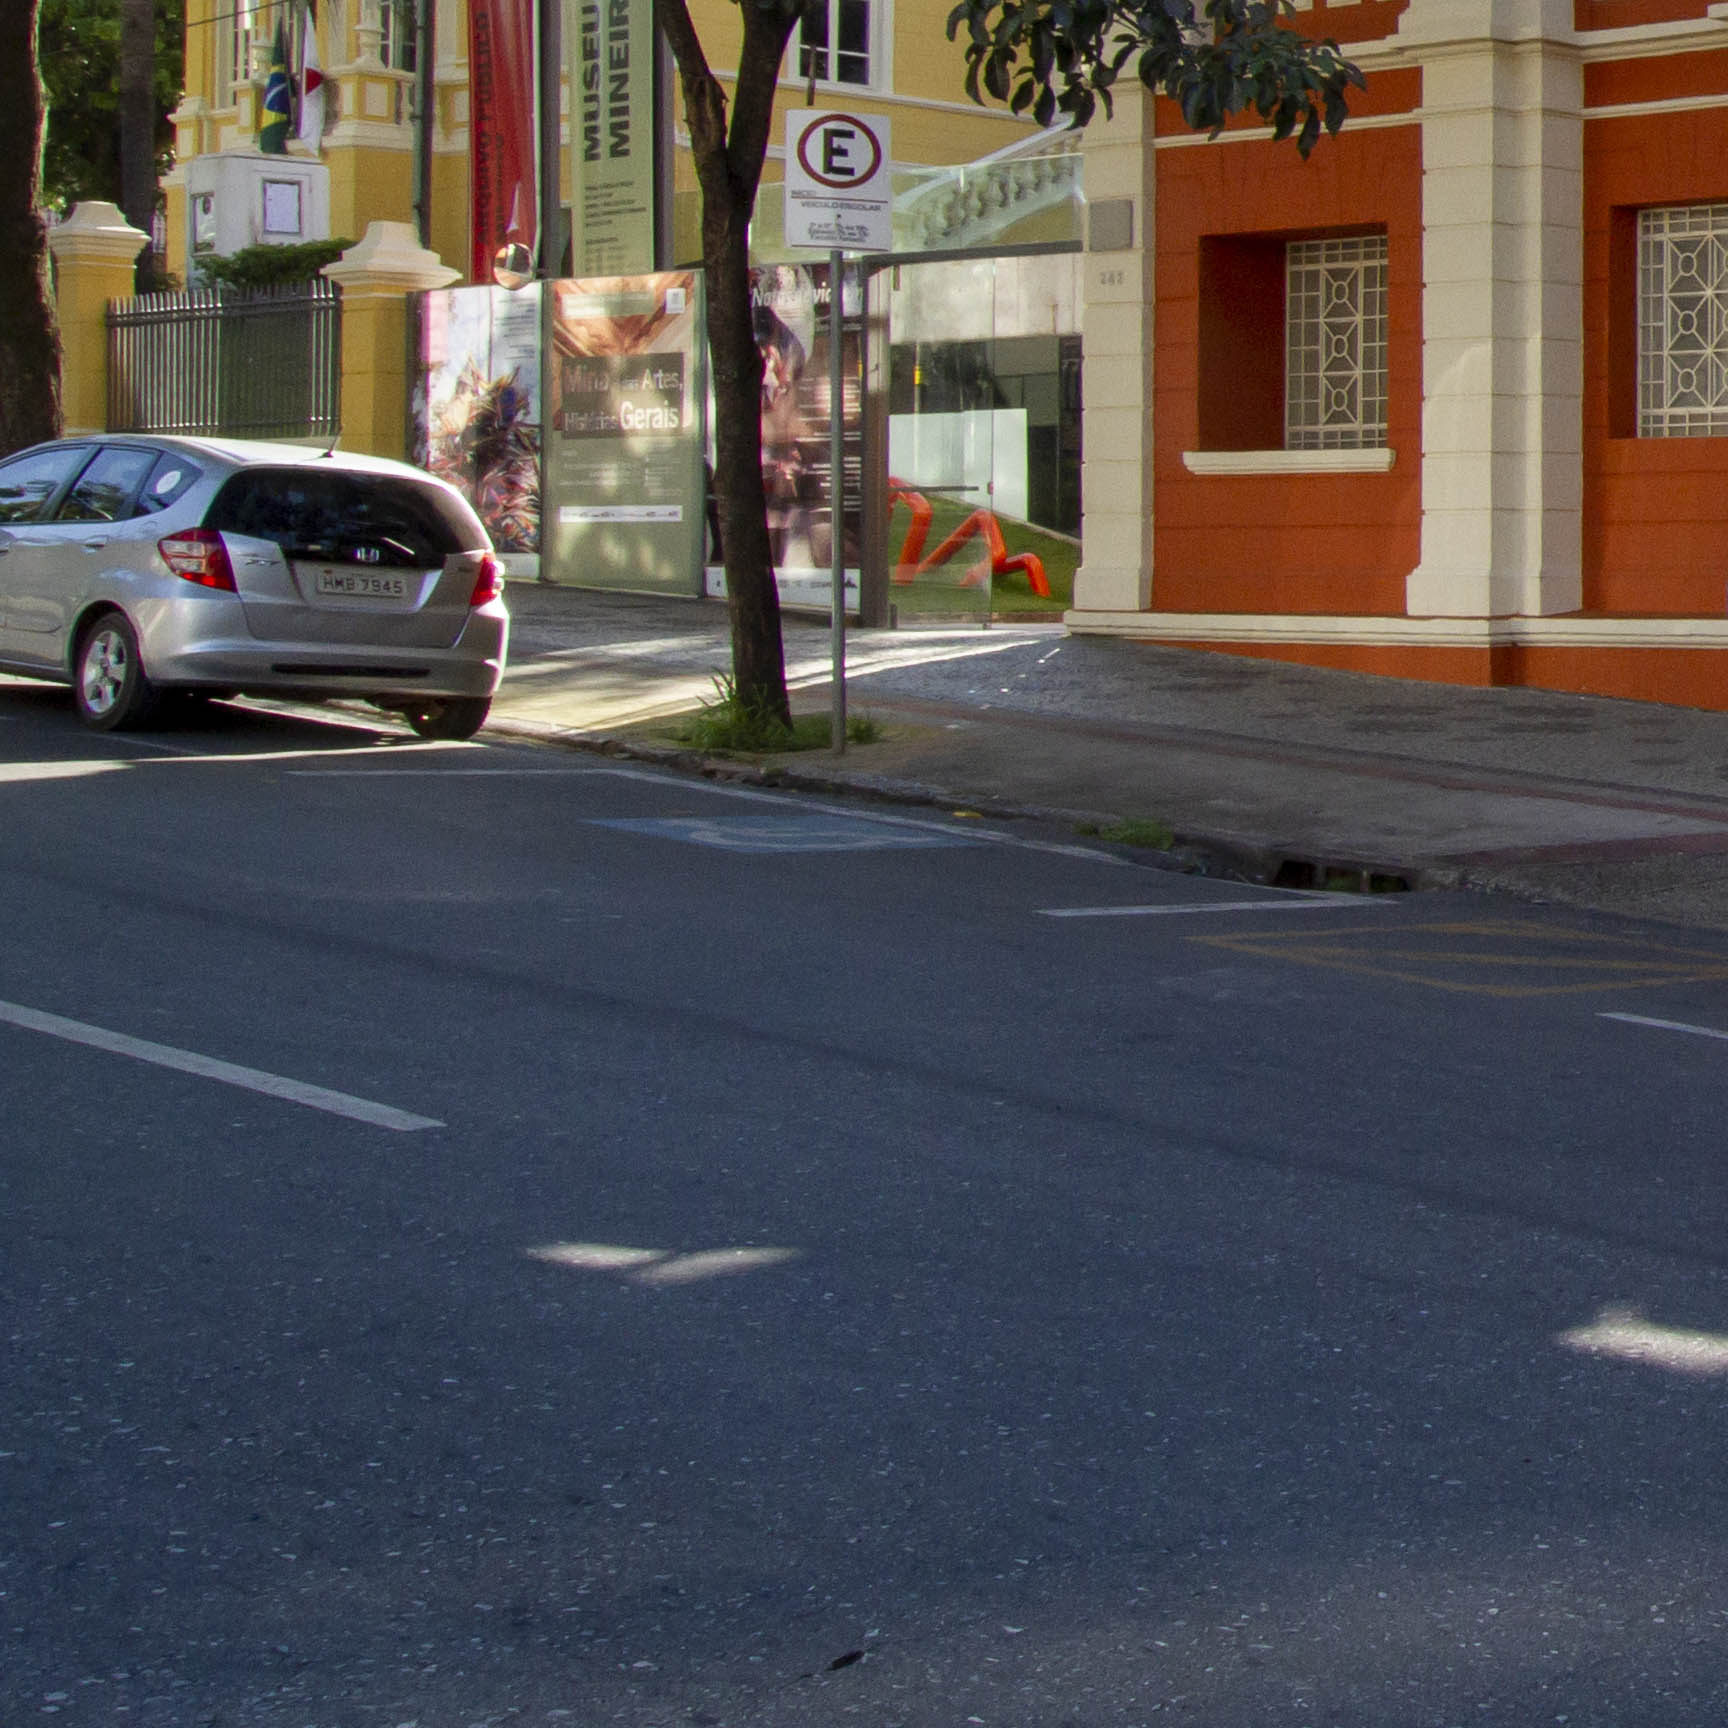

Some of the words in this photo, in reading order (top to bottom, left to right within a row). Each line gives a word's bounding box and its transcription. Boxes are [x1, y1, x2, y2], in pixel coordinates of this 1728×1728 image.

[581, 4, 601, 163] MUSEU
[822, 128, 856, 176] E
[476, 130, 491, 245] ARQUIVO
[642, 367, 684, 392] Artes,
[620, 400, 679, 430] Gerais
